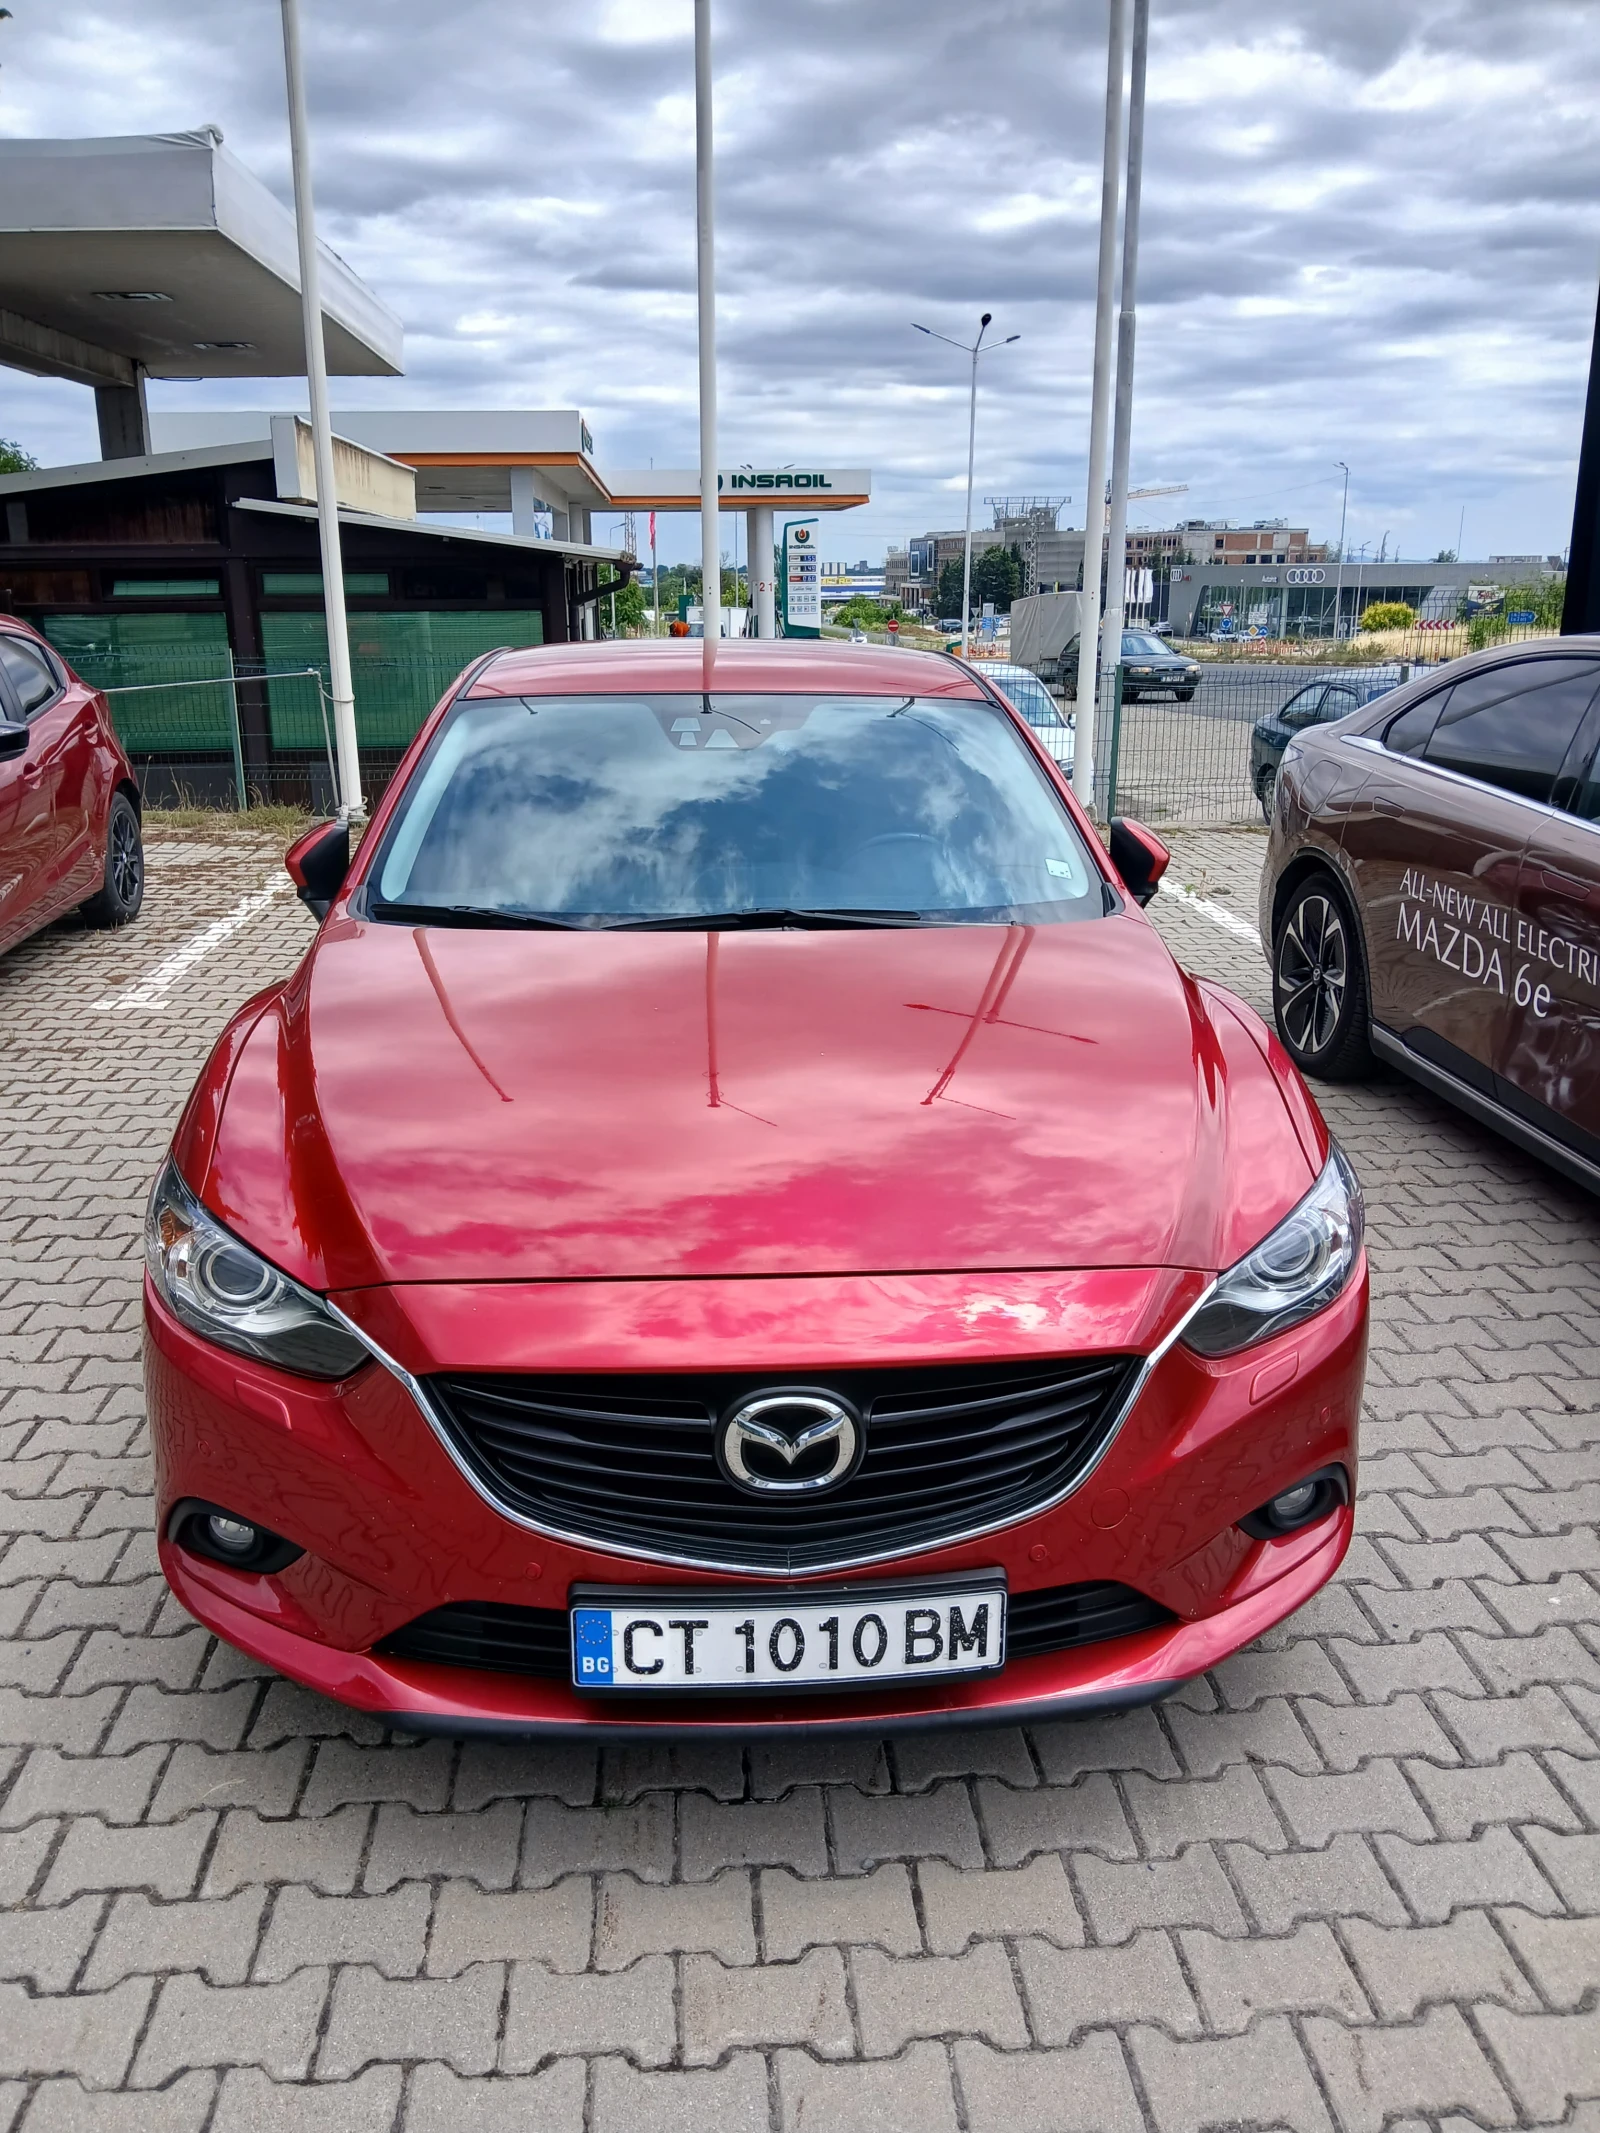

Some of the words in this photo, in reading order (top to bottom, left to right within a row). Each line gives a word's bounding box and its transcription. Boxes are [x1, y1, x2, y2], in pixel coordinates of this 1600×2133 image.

[731, 474, 832, 488] INSAOIL
[1400, 868, 1475, 924] ALL-NEW
[1478, 904, 1511, 944] ALL
[1396, 902, 1504, 995] MAZDA
[1514, 963, 1551, 1018] 6e
[582, 1656, 610, 1673] BG
[623, 1620, 709, 1676] CT
[735, 1612, 889, 1674] 1010
[904, 1603, 989, 1664] BM
